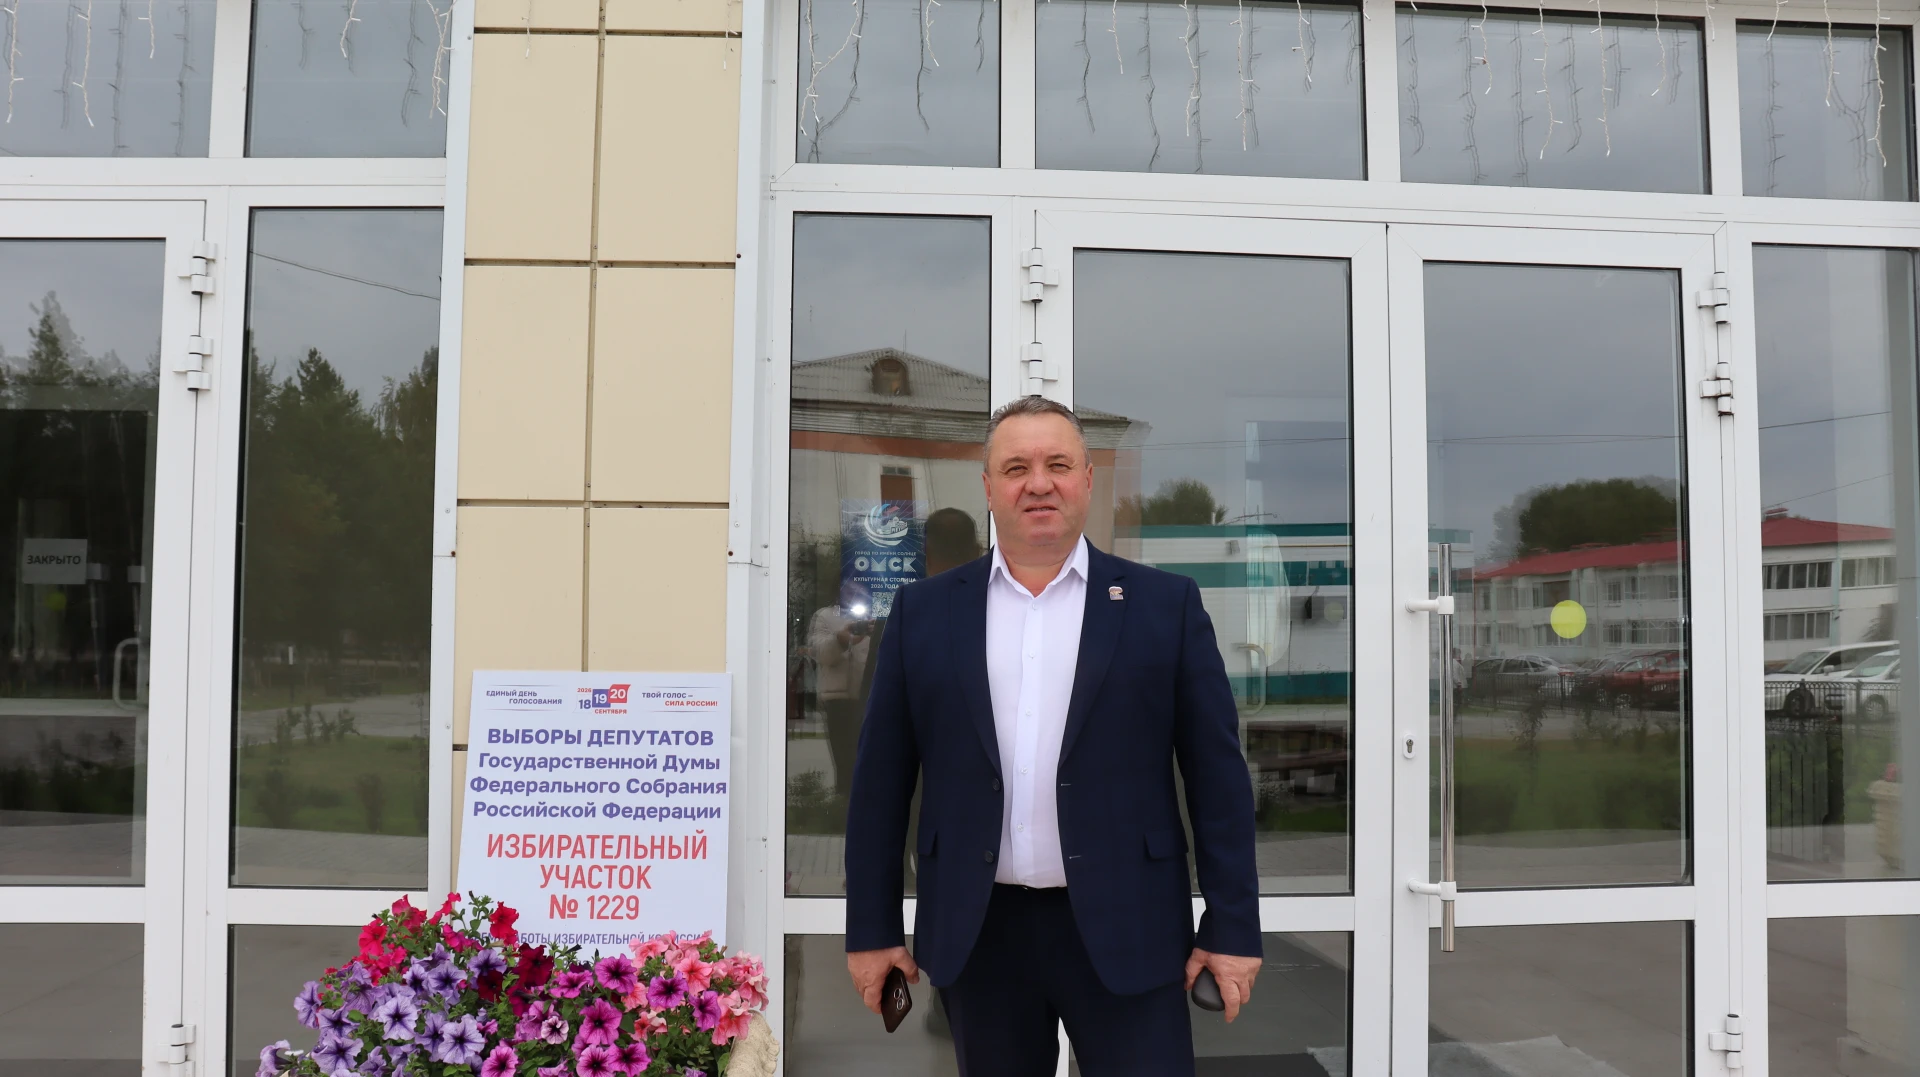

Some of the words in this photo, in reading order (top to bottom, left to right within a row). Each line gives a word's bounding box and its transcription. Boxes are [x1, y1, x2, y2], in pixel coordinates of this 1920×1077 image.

[27, 555, 81, 564] ЗАКРЫТО
[854, 557, 916, 572] ОМСК
[486, 689, 515, 697] ЕДИНЫЙ
[579, 699, 591, 710] 18
[594, 693, 607, 704] 19
[610, 689, 626, 699] 20
[642, 691, 661, 699] ТВОЙ
[487, 729, 581, 744] ВЫБОРЫ
[587, 730, 714, 746] ДЕПУТАТОВ
[479, 753, 657, 772] Государственной
[662, 755, 720, 773] Думы
[470, 776, 620, 796] Федерального
[626, 779, 727, 797] Собрания
[473, 801, 595, 818] Российской
[602, 802, 721, 822] Федерации
[487, 830, 707, 859] ИЗБИРАТЕЛЬНЫЙ
[539, 865, 652, 889] УЧАСТОК
[549, 894, 579, 919] №
[587, 895, 640, 920] 1229
[516, 933, 550, 943] АБОТЫ
[554, 932, 645, 944] ИЗБИРАТЕЛЬНОЙ
